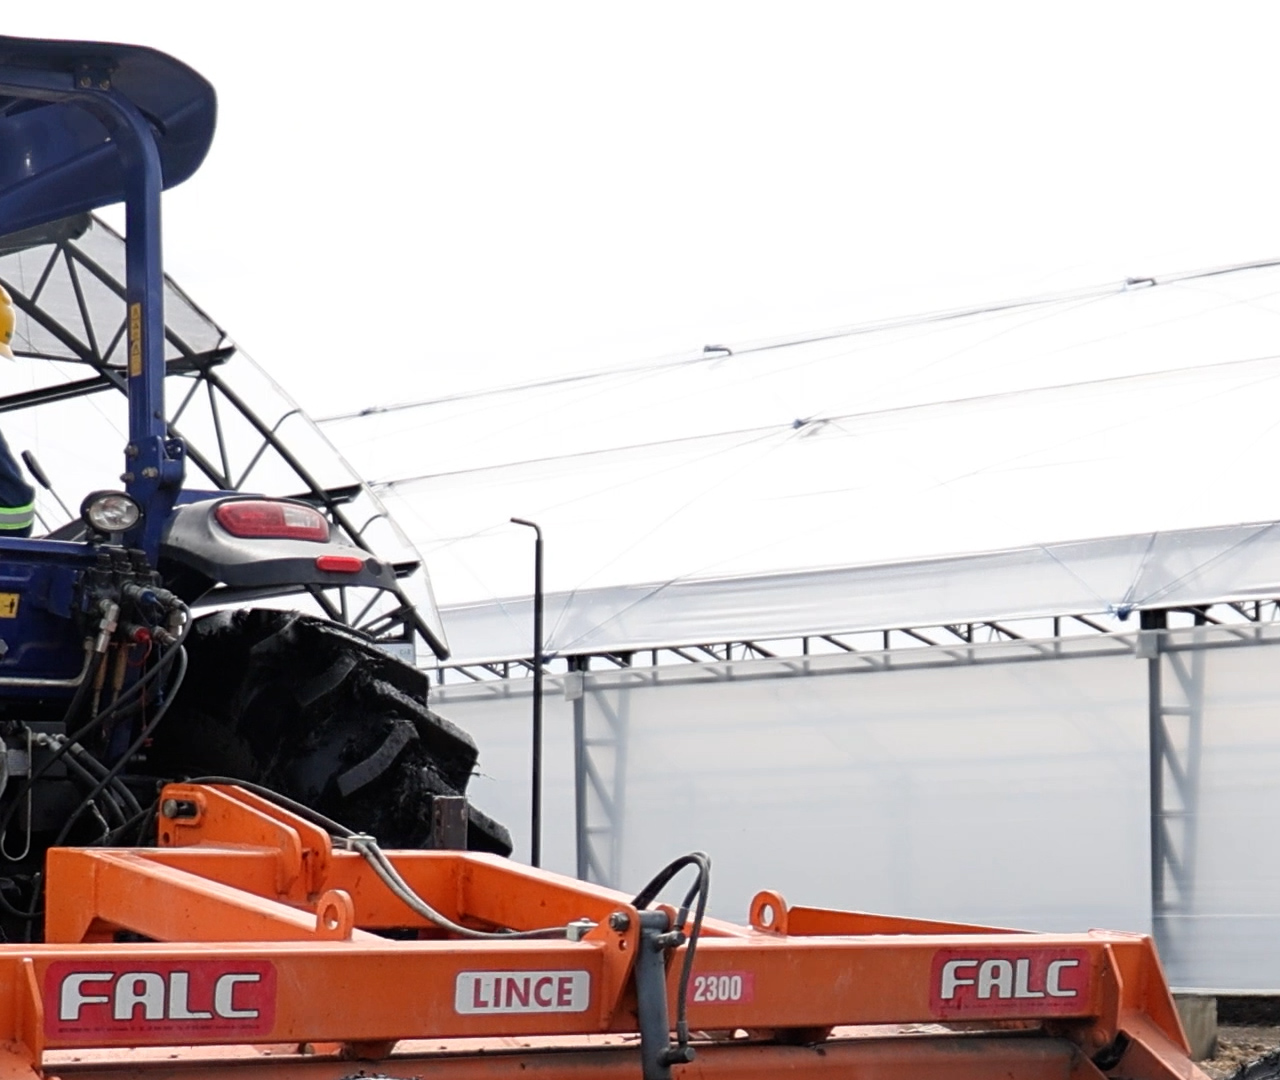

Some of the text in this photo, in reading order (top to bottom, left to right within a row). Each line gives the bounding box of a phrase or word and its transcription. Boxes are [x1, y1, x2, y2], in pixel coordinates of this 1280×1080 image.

[59, 971, 261, 1021] FALC
[473, 976, 574, 1008] LINCE
[693, 975, 742, 1002] 2300
[940, 958, 1080, 999] FALC
